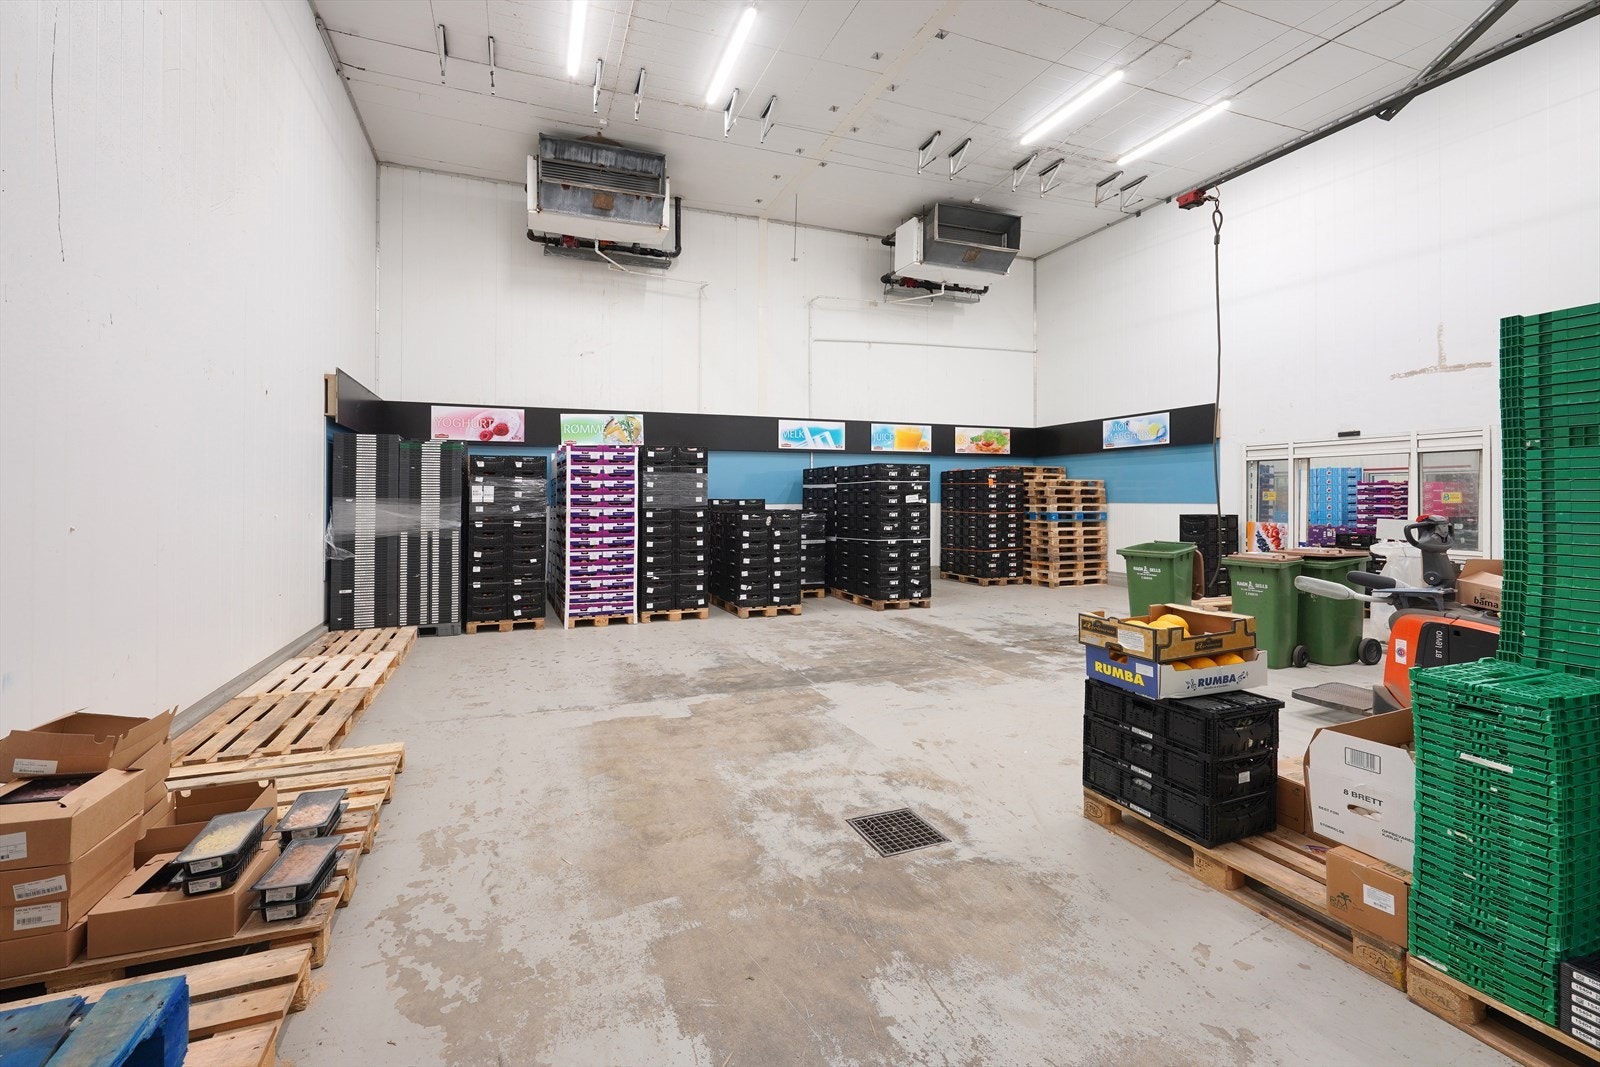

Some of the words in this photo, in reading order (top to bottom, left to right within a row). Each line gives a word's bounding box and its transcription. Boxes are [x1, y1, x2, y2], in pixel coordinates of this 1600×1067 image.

[434, 416, 494, 429] YOGHURT
[783, 429, 805, 439] MELK
[873, 432, 894, 442] JUICE
[1095, 660, 1145, 687] RUMBA
[1197, 673, 1236, 688] RUMBA
[1343, 788, 1349, 796] 8
[1351, 791, 1384, 807] BRETT
